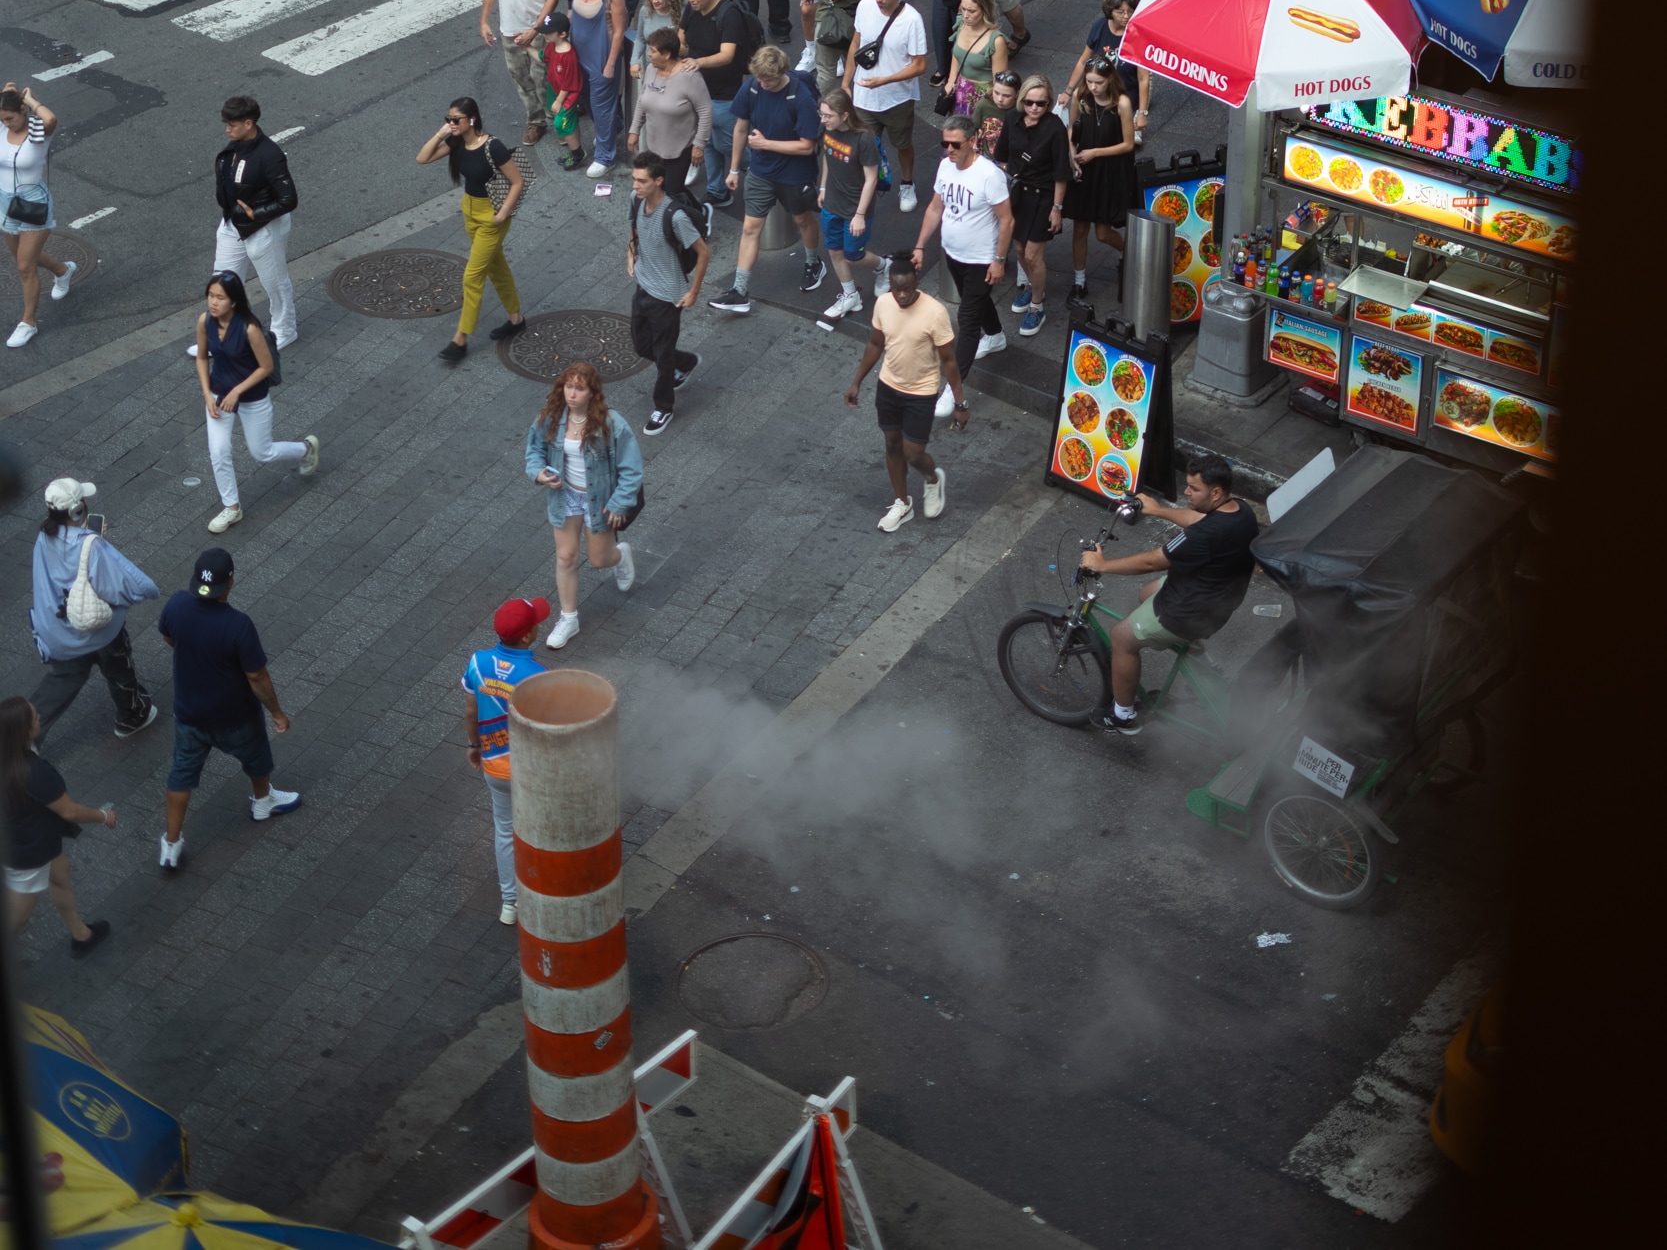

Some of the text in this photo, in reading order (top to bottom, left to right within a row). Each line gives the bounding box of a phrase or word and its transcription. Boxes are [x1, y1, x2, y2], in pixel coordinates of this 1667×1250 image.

[1430, 17, 1478, 59] HOT DOGS
[1144, 44, 1229, 92] COLD DRINKS
[1532, 62, 1576, 79] COLD
[1294, 75, 1371, 97] HOT DOGS
[940, 182, 974, 211] GANT
[1284, 318, 1328, 338] ITALIAN SAUSAGE
[499, 660, 511, 669] VF
[1298, 756, 1318, 774] RIDE
[1300, 750, 1329, 772] MINUTE
[1326, 757, 1342, 771] PER
